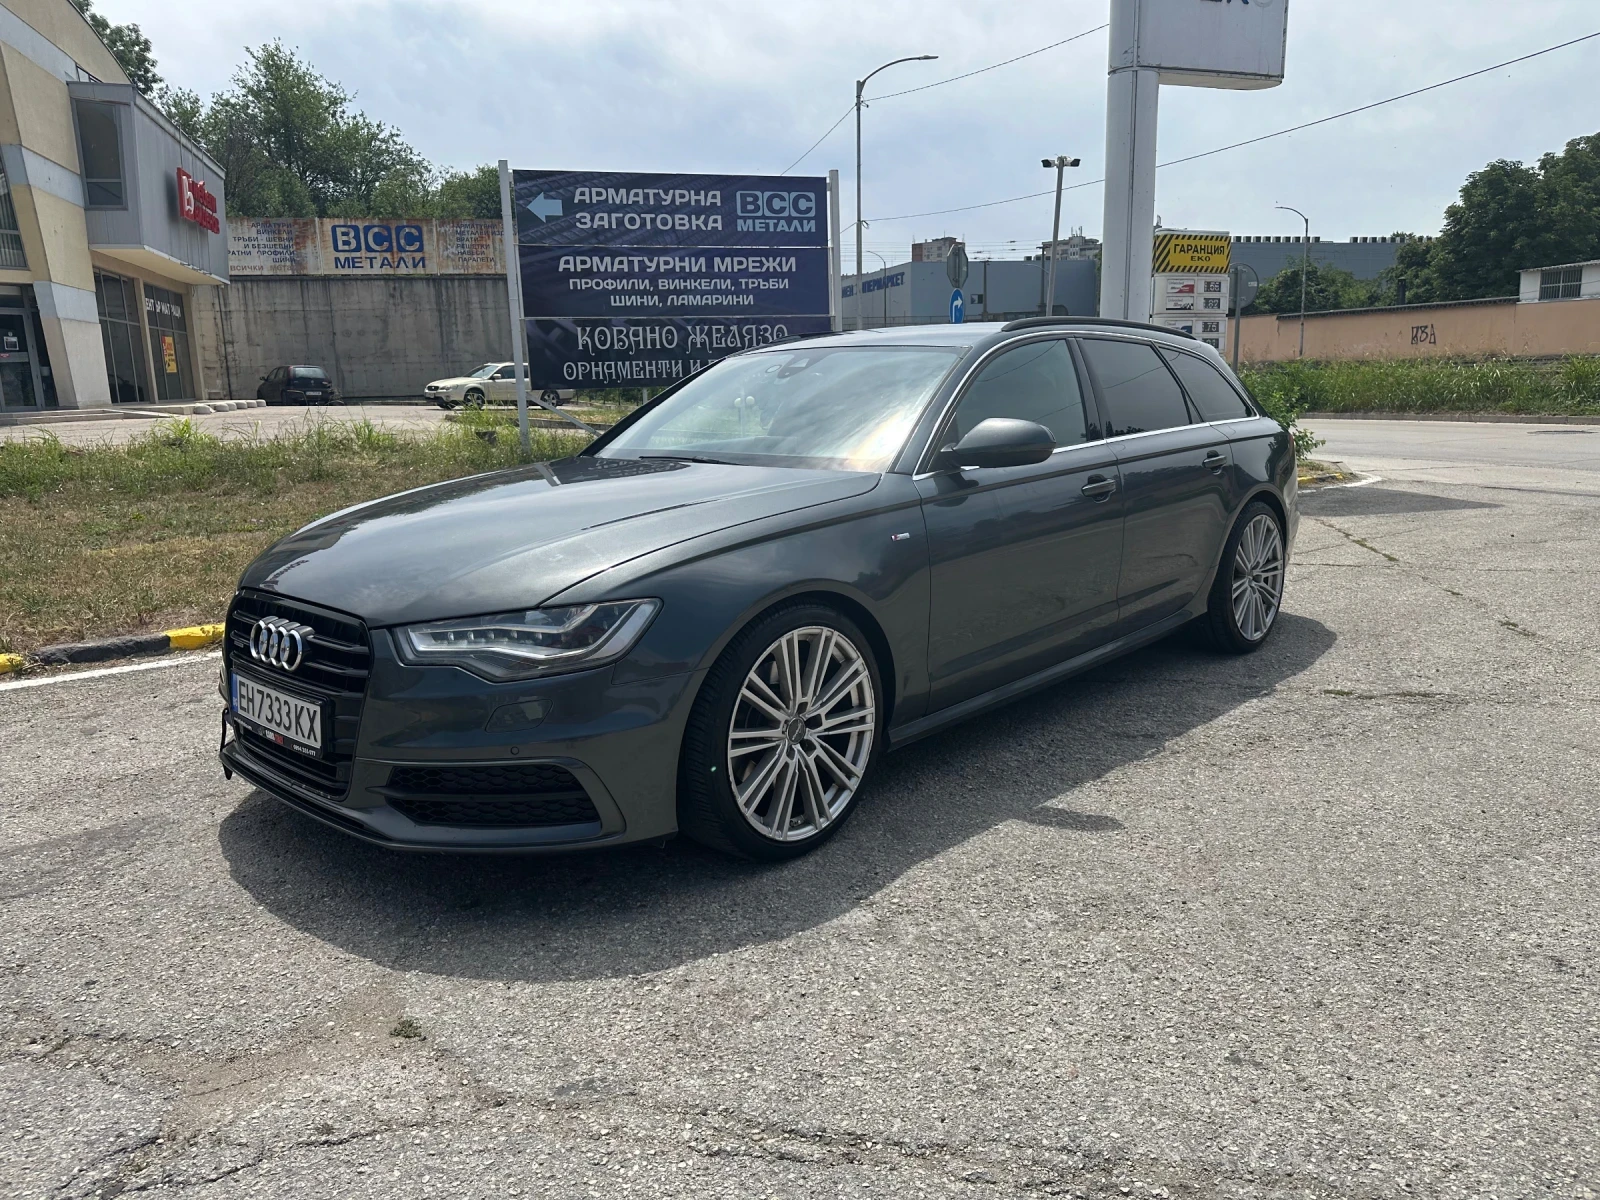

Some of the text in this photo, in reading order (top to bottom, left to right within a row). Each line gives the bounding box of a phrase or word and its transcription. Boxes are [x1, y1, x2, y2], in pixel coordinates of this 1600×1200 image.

[574, 187, 721, 206] АРМАТУРНА
[575, 212, 722, 231] ЗАГОТОВКА
[736, 218, 816, 232] МЕТАЛИ
[1173, 243, 1225, 256] ГАРАНЦИЯ
[334, 256, 426, 269] МЕТАЛИ
[558, 256, 796, 273] АРМАТУРНИ МРЕЖИ
[569, 278, 789, 291] ПРОФИЛИ, ВИНКЕЛИ, ТРЪБИ
[610, 295, 754, 307] ШИНИ, ЛАМАРИНИ
[576, 326, 678, 355] КОВАНО
[563, 360, 683, 383] ОРНАМЕНТИ
